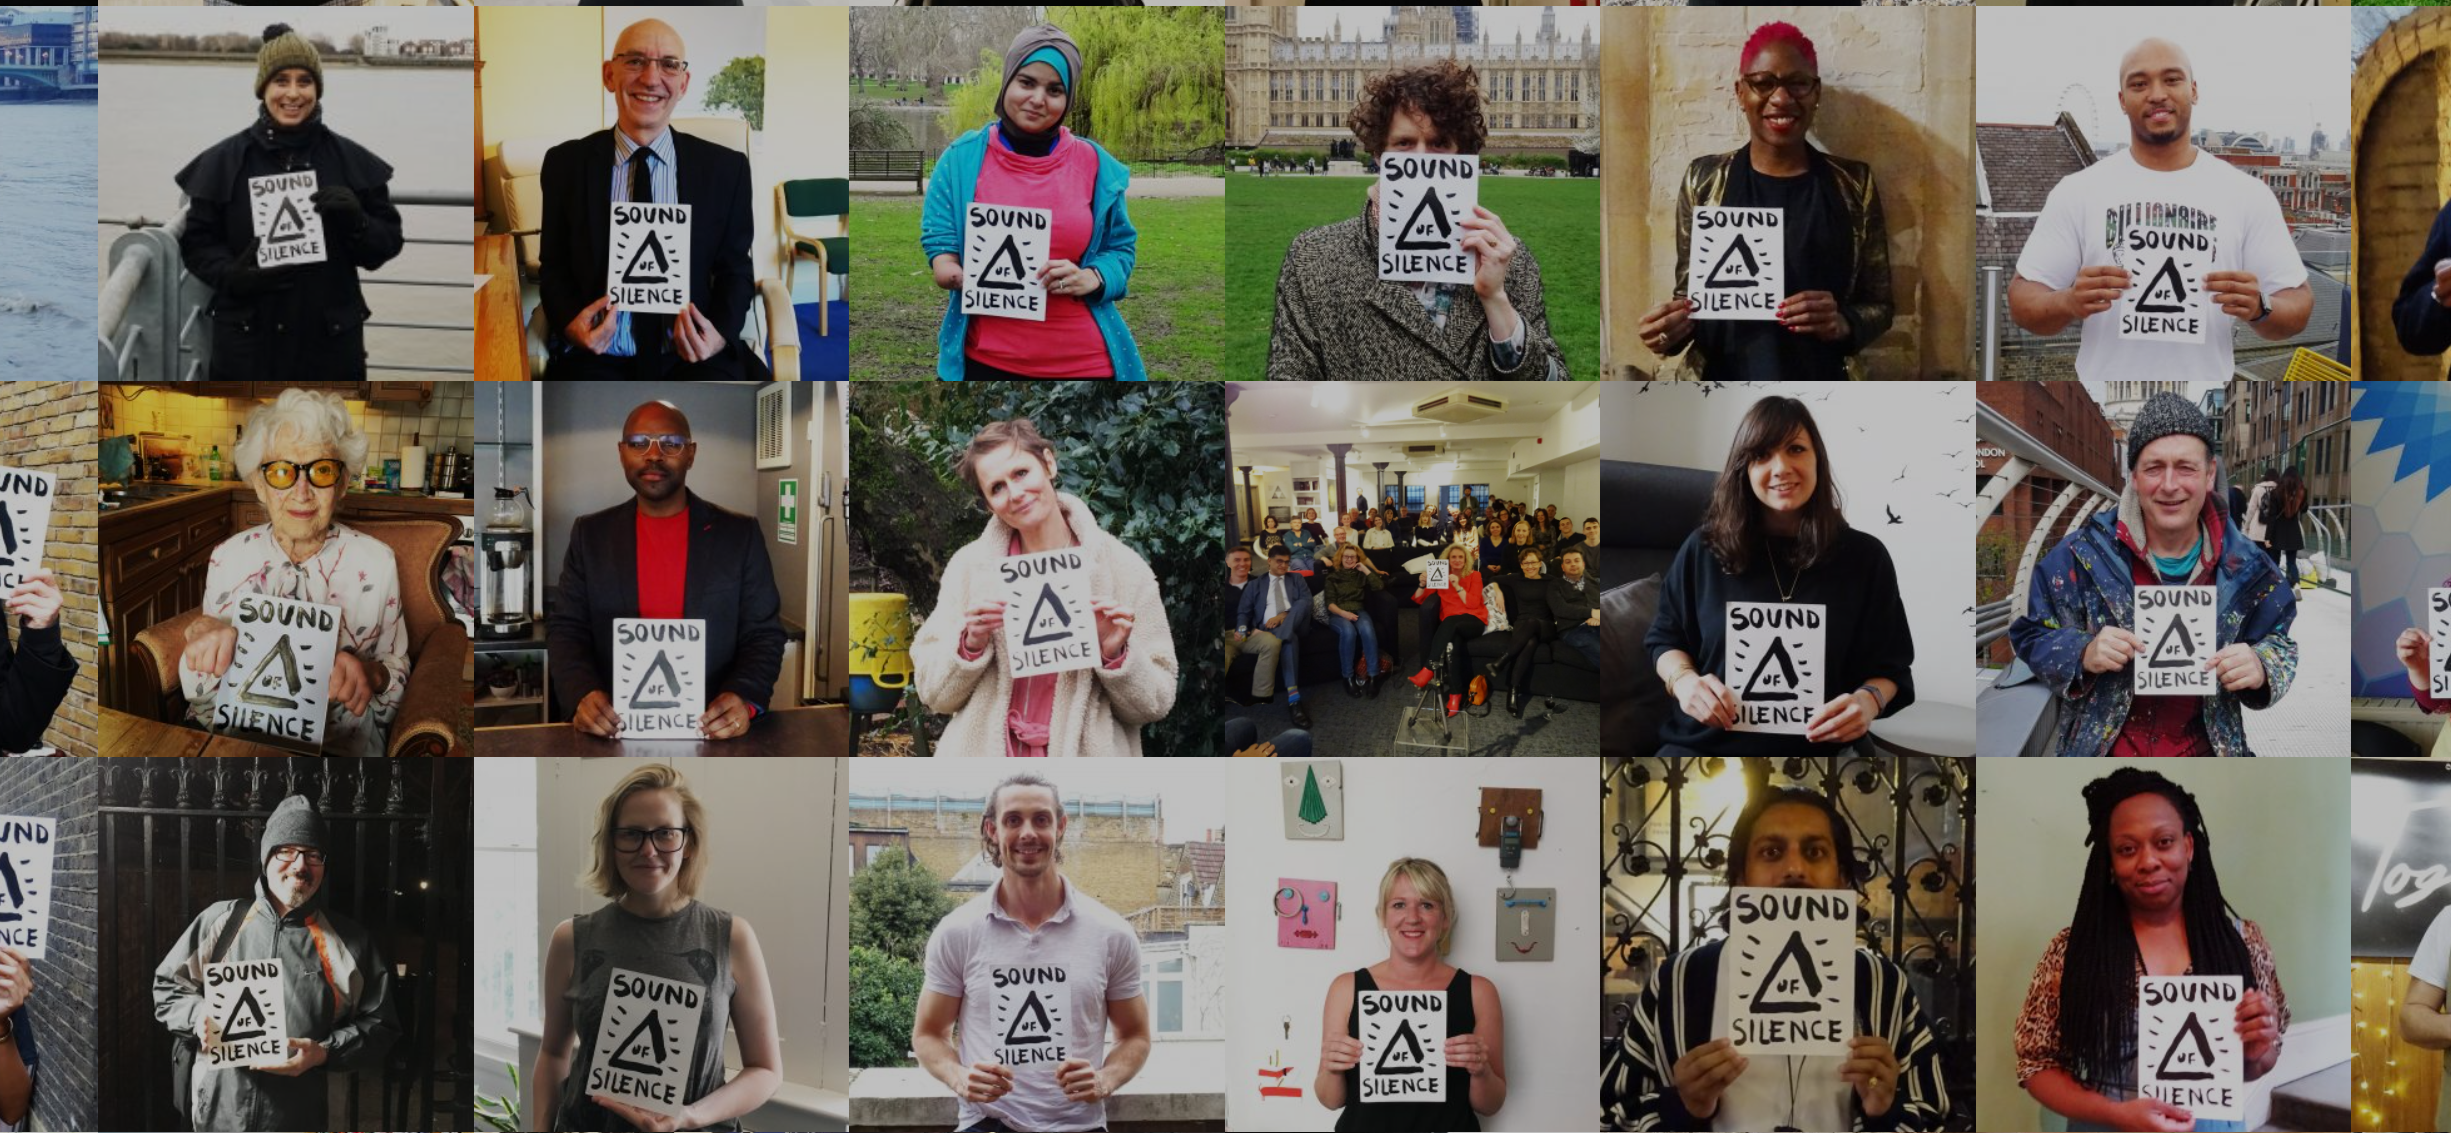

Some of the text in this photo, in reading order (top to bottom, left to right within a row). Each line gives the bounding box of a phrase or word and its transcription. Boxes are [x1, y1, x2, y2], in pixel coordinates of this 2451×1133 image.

[1384, 158, 1473, 181] SOUND
[252, 178, 312, 196] SOUND
[614, 206, 686, 226] SOUND
[970, 207, 1046, 230] SOUND
[1697, 211, 1778, 230] SOUND
[2129, 230, 2208, 251] SOUND
[260, 241, 320, 262] SILENCE
[1382, 253, 1467, 274] SILENCE
[610, 287, 682, 306] SILENCE
[965, 291, 1038, 311] SILENCE
[1691, 292, 1775, 312] SILENCE
[2123, 316, 2198, 334] SILENCE
[1976, 448, 2006, 457] NDON
[1000, 554, 1081, 583] SOUND
[2138, 590, 2212, 610] SOUND
[239, 601, 333, 633] SOUND
[1730, 607, 1820, 631] SOUND
[617, 623, 700, 645] SOUND
[1013, 642, 1090, 671] SILENCE
[2138, 671, 2208, 689] SILENCE
[217, 704, 315, 742] SILENCE
[1736, 894, 1849, 924] SOUND
[207, 963, 278, 987] SOUND
[993, 967, 1066, 988] SOUND
[613, 974, 698, 1009] SOUND
[2143, 981, 2237, 1006] SOUND
[1362, 994, 1442, 1016] SOUND
[1733, 1018, 1842, 1046] SILENCE
[210, 1040, 280, 1065] SILENCE
[994, 1047, 1065, 1066] SILENCE
[590, 1068, 675, 1106] SILENCE
[1363, 1078, 1438, 1097] SILENCE
